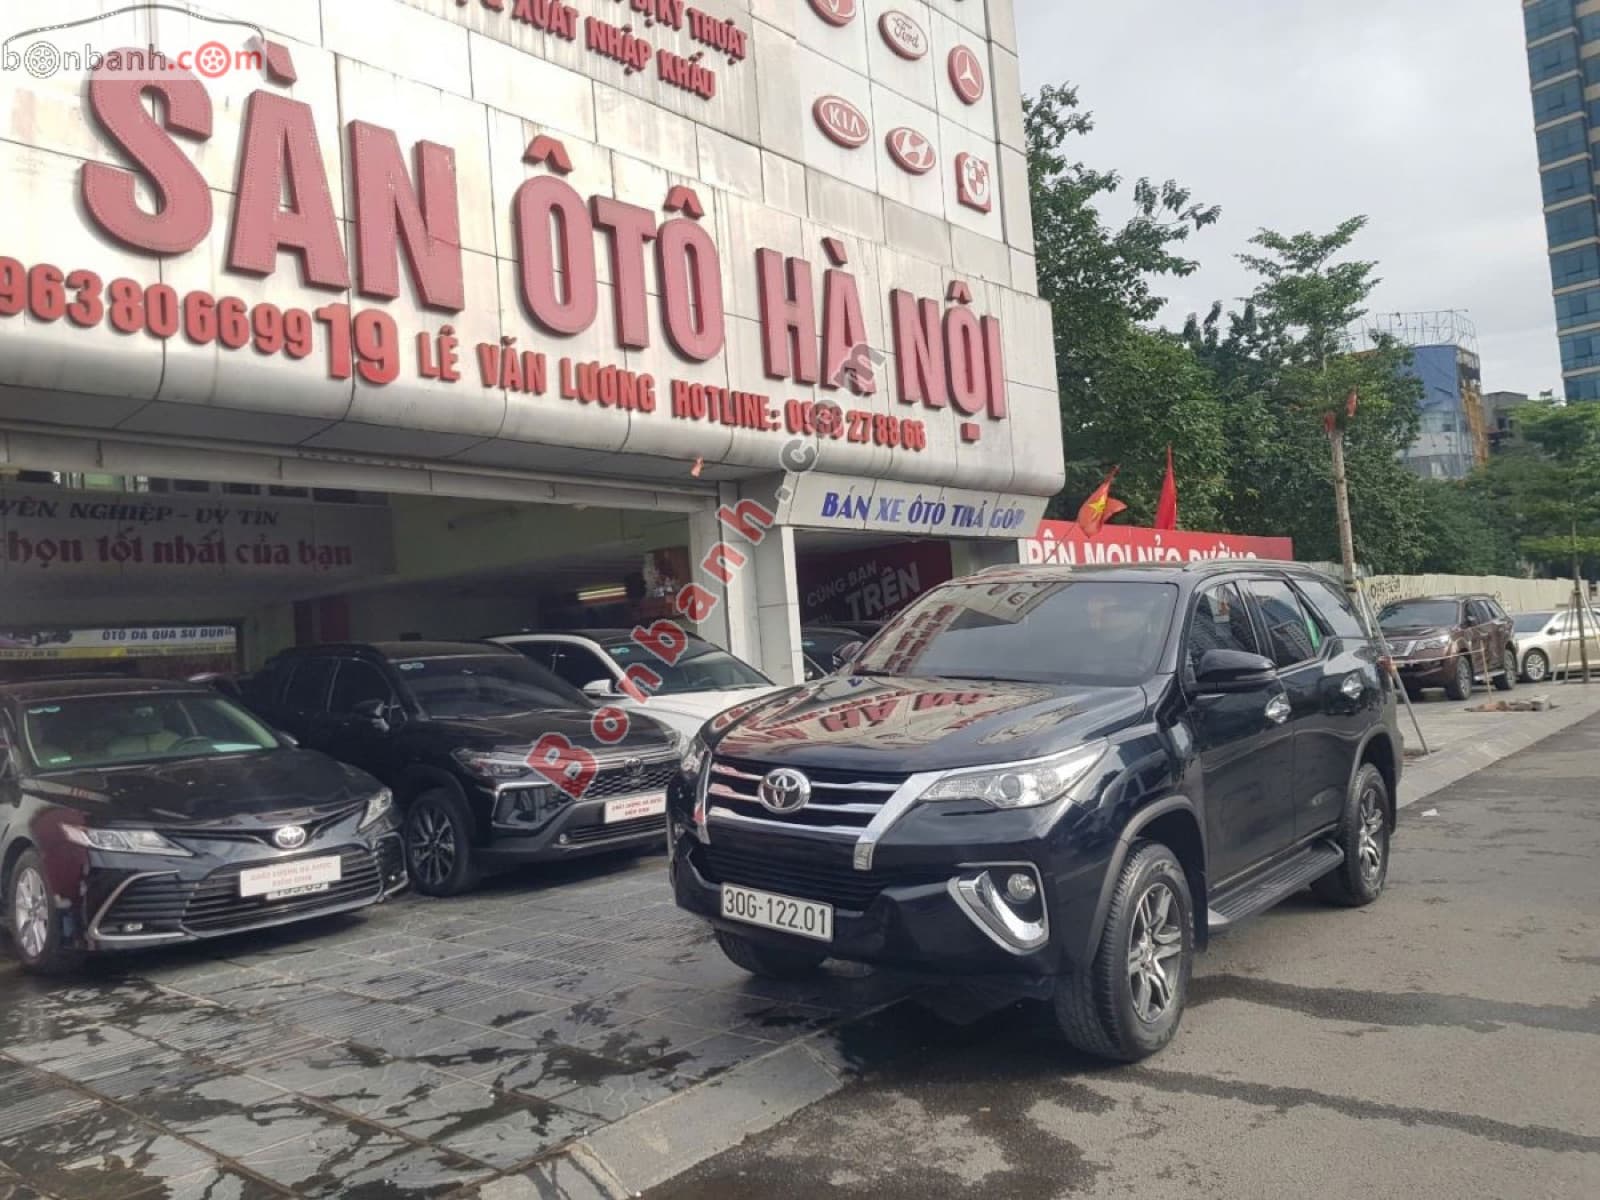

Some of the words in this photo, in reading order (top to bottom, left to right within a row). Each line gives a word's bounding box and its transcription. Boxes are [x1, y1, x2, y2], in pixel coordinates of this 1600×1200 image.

[585, 15, 652, 76] NHẬP
[687, 7, 748, 65] THUẬT
[827, 104, 863, 137] KIA
[511, 133, 725, 362] ÔTÔ
[755, 237, 877, 396] HÀ
[889, 280, 1007, 443] NỘI
[415, 324, 461, 383] LÊ
[476, 335, 546, 395] VĂN
[559, 357, 656, 413] LƯƠNG
[671, 379, 782, 432] HOTLINE:
[70, 502, 173, 526] NGHIỆP
[820, 485, 873, 521] BÁN
[875, 496, 905, 523] XE
[97, 526, 144, 564] tốt
[152, 528, 226, 565] nhất
[236, 532, 290, 566] của
[298, 538, 353, 571] bạn
[844, 561, 922, 623] TRÊN
[725, 888, 827, 936] 30G-122.01
